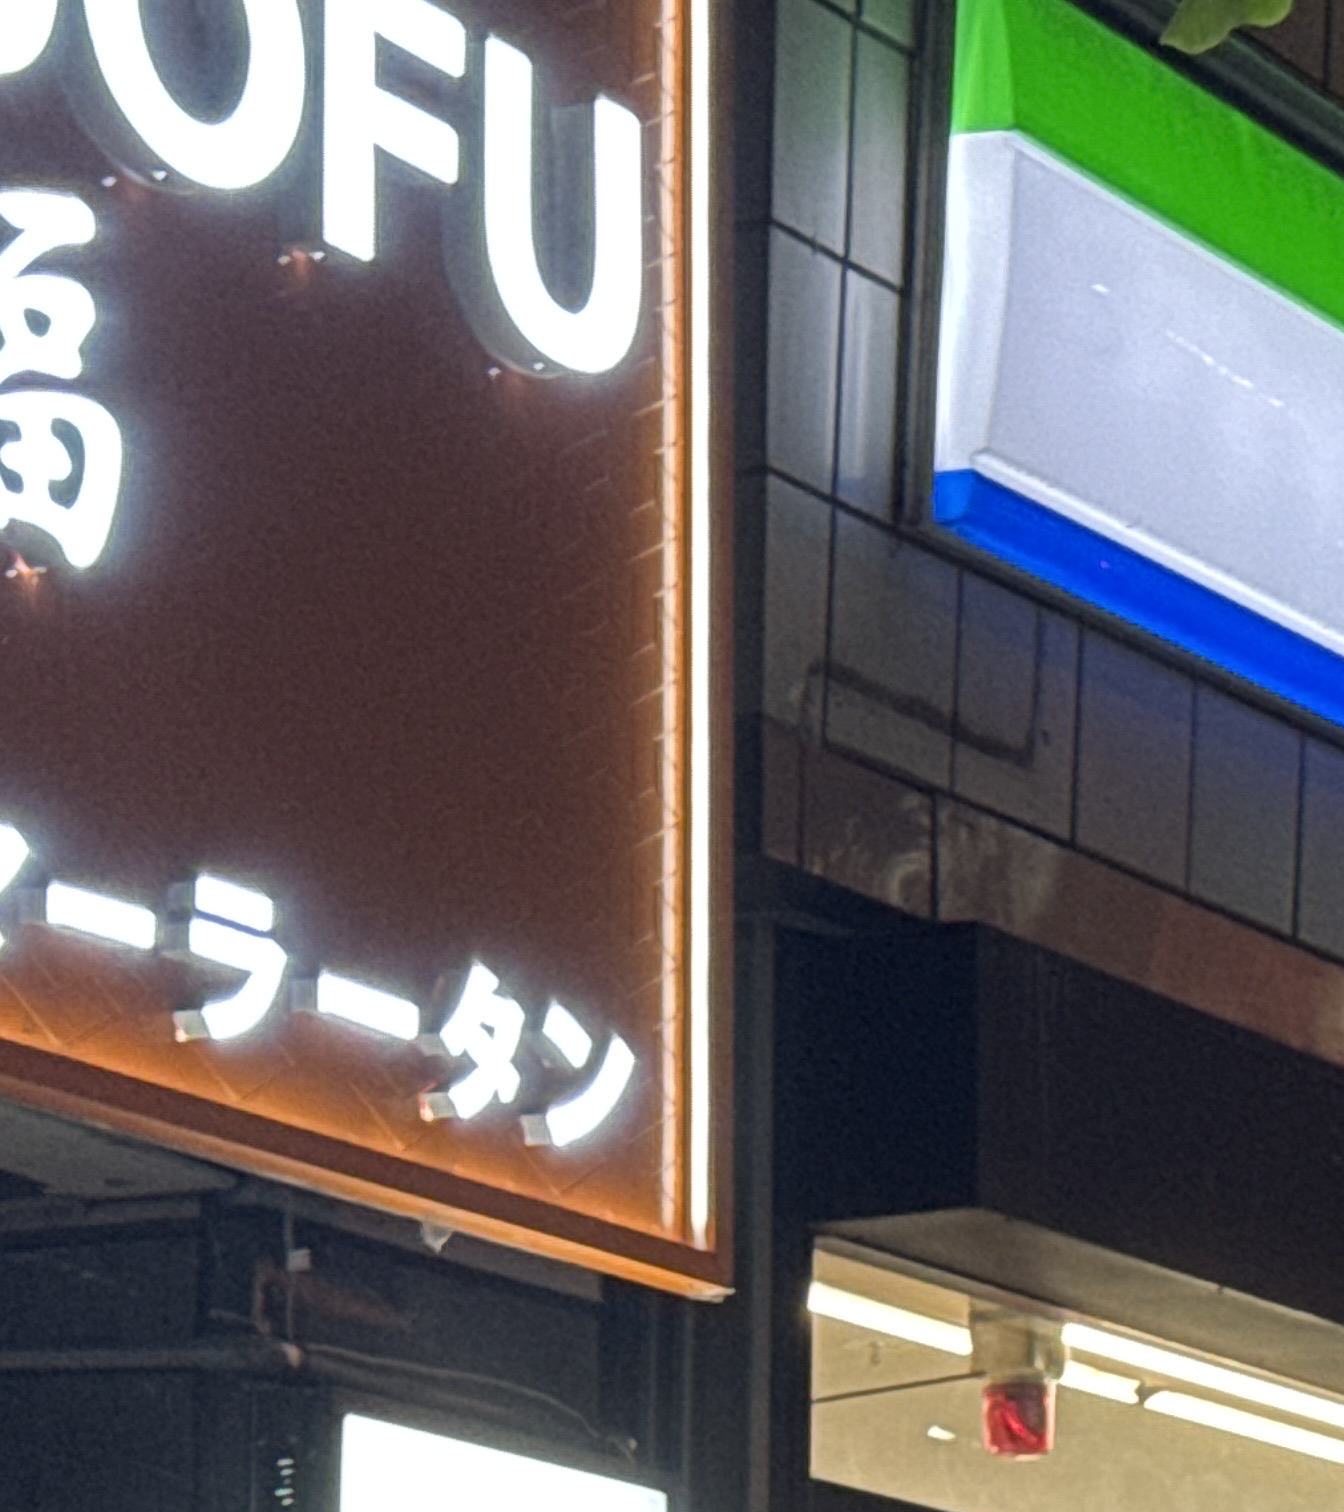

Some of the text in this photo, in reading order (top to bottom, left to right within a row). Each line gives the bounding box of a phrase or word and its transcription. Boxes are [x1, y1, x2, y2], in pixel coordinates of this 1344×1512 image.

[0, 0, 643, 375] OFU
[0, 822, 636, 1148] ーラータン
